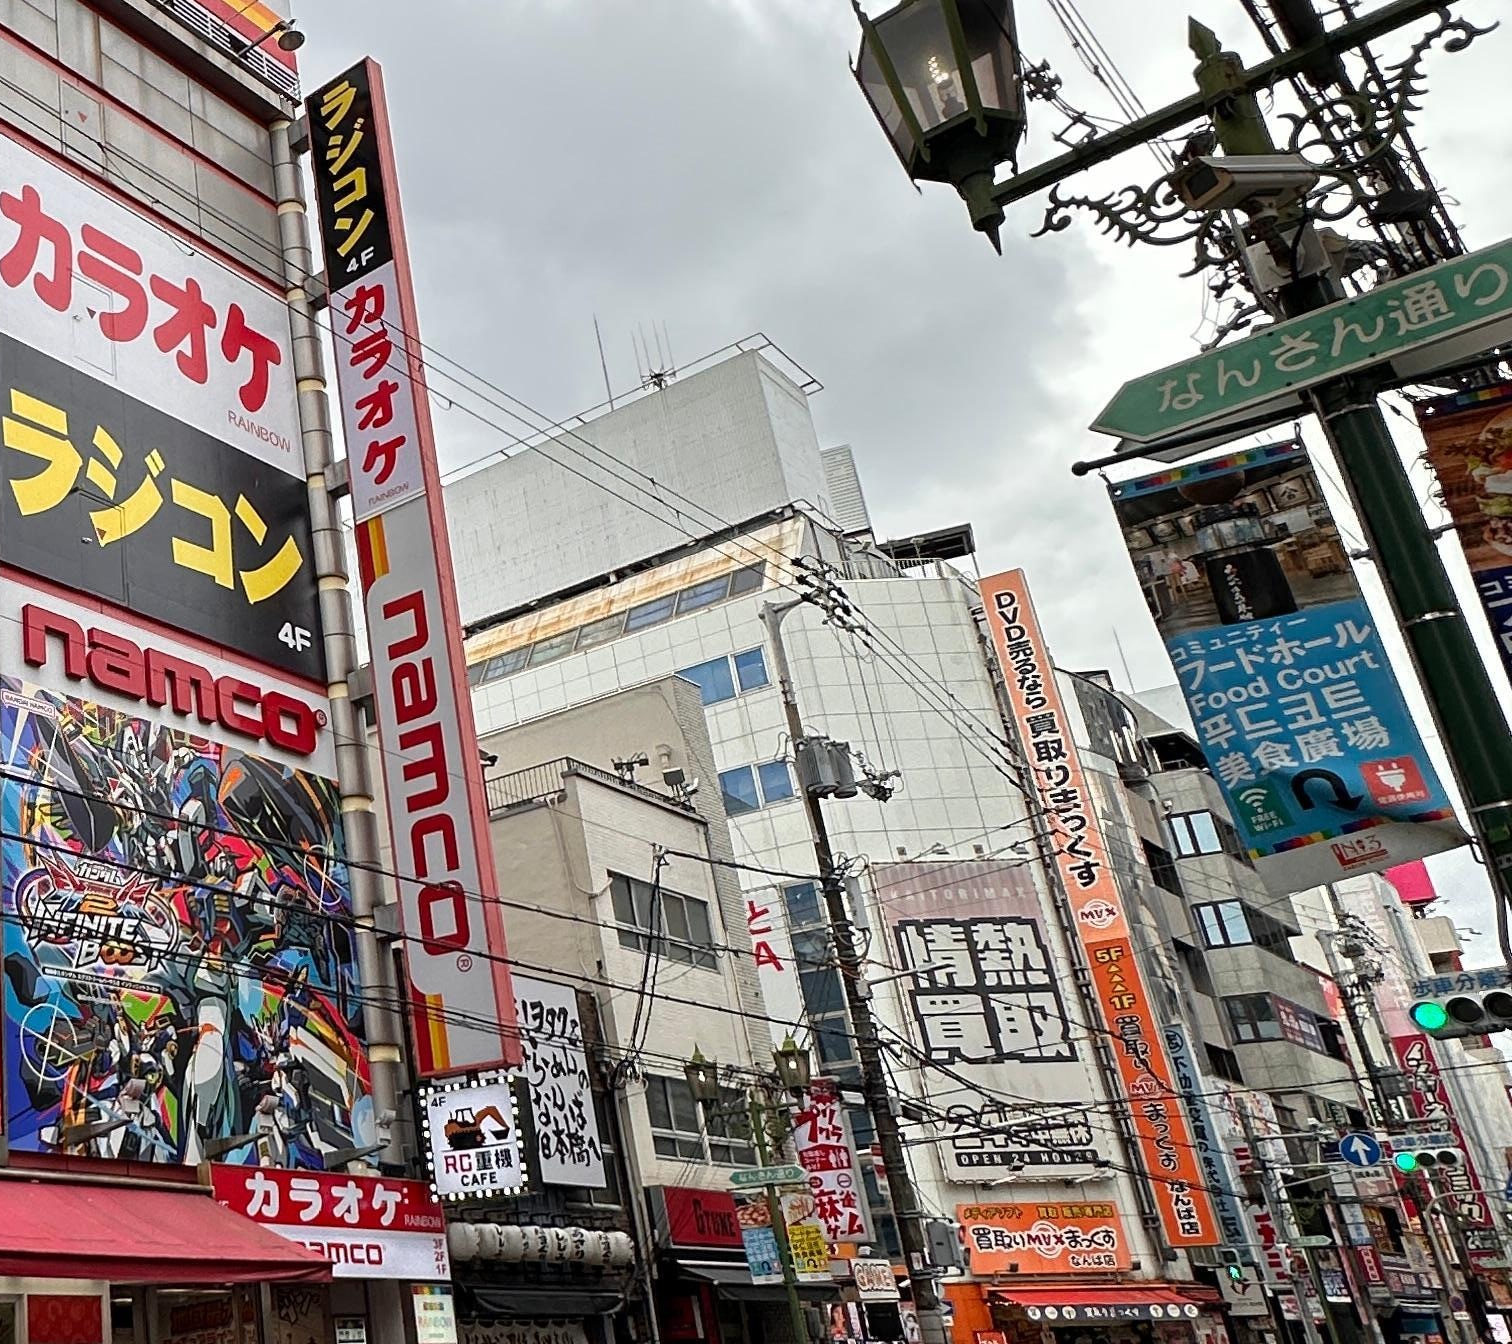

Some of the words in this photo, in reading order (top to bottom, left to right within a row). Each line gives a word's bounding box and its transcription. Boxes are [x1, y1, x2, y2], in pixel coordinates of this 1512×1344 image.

[320, 79, 375, 257] ラジコン
[345, 246, 375, 273] 4F
[1157, 262, 1510, 414] なんさん通り
[344, 283, 408, 486] カラオケ
[227, 408, 292, 454] RAINBOW
[1, 387, 304, 605] ラジコン
[368, 480, 410, 506] RAINBOW
[277, 621, 312, 652] 4F
[1169, 616, 1308, 663] コミュニティー
[1178, 618, 1372, 691] フードホール
[1189, 677, 1271, 717] Food
[1276, 649, 1381, 691] Court
[1200, 679, 1372, 749] 푸드코트
[1215, 716, 1391, 790] 美食廣場
[1250, 810, 1279, 824] FREE
[890, 886, 1027, 902] KAITORIMAX
[898, 920, 1053, 990] 情熱
[1095, 946, 1124, 963] 5F
[1109, 993, 1136, 1010] 1F
[915, 990, 1071, 1060] 買取
[430, 1095, 447, 1108] 4F
[960, 1153, 1003, 1166] OPEN
[460, 1171, 498, 1187] CAFE
[244, 1170, 403, 1227] カラオケ
[1165, 1178, 1202, 1236] なんば店
[404, 1213, 442, 1229] RAINBOW
[296, 1240, 384, 1265] amco
[432, 1237, 445, 1251] 3F
[433, 1250, 446, 1263] 2F
[435, 1263, 448, 1276] 1F
